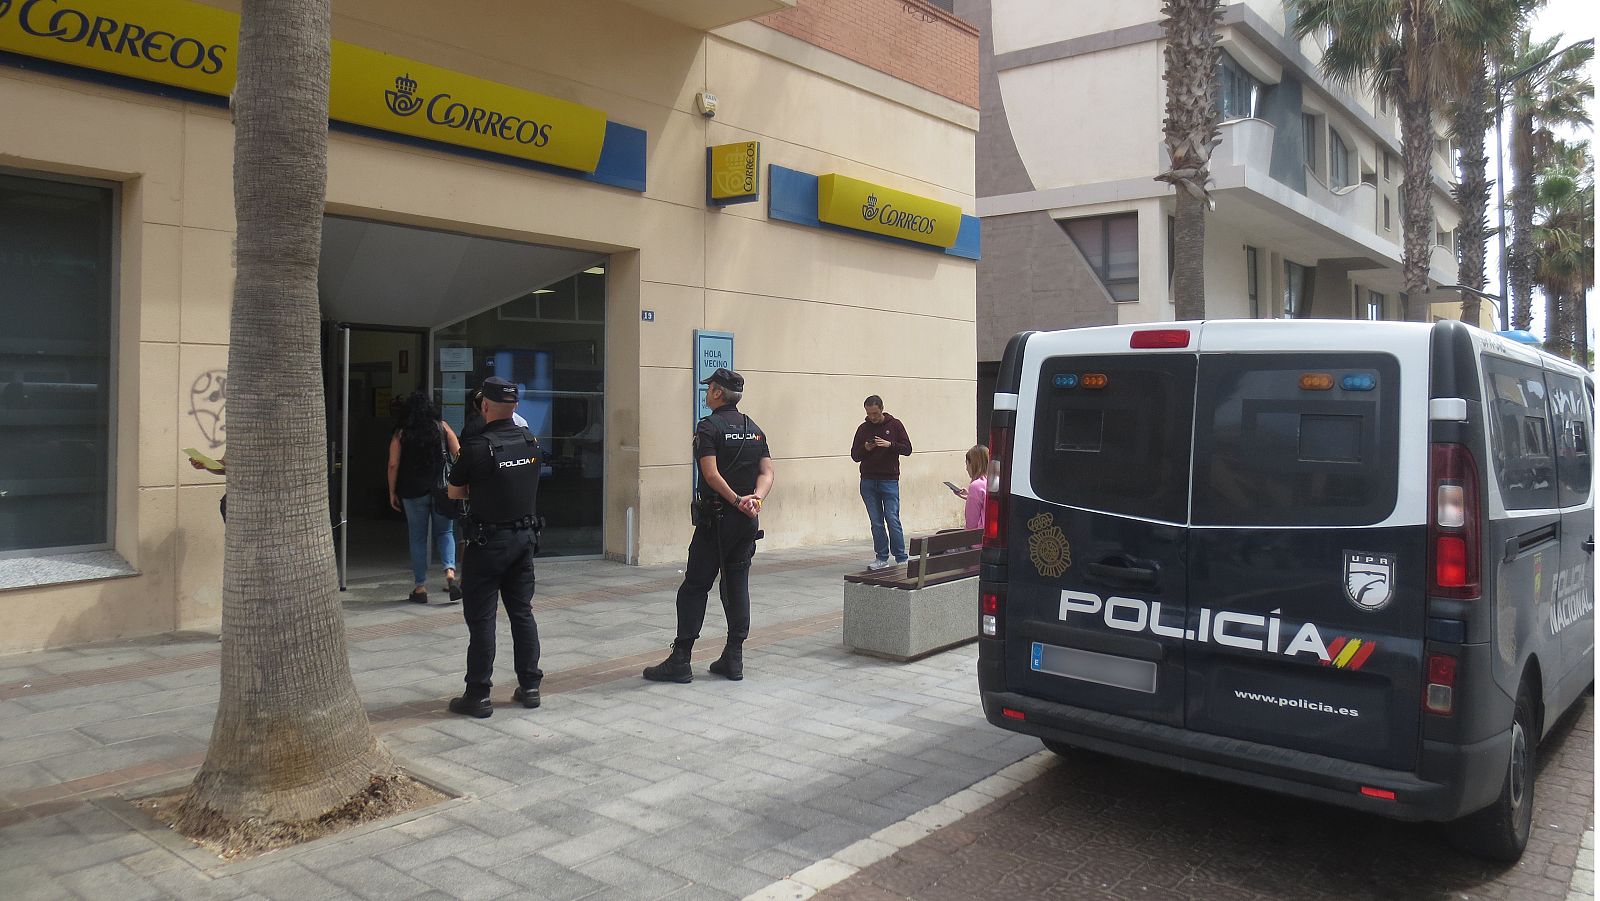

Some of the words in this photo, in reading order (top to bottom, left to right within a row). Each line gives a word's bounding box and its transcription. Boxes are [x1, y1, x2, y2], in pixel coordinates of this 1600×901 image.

[19, 0, 227, 75] CORREOS
[426, 93, 552, 148] CORREOS
[743, 142, 755, 192] CORREOS
[879, 204, 937, 234] CORREOS
[643, 311, 653, 320] 19
[704, 349, 722, 359] HOLA
[704, 359, 728, 368] VECINO
[1058, 589, 1332, 662] POLICÍA
[1549, 587, 1594, 636] NACIONAL
[1234, 688, 1360, 718] www.policia.es
